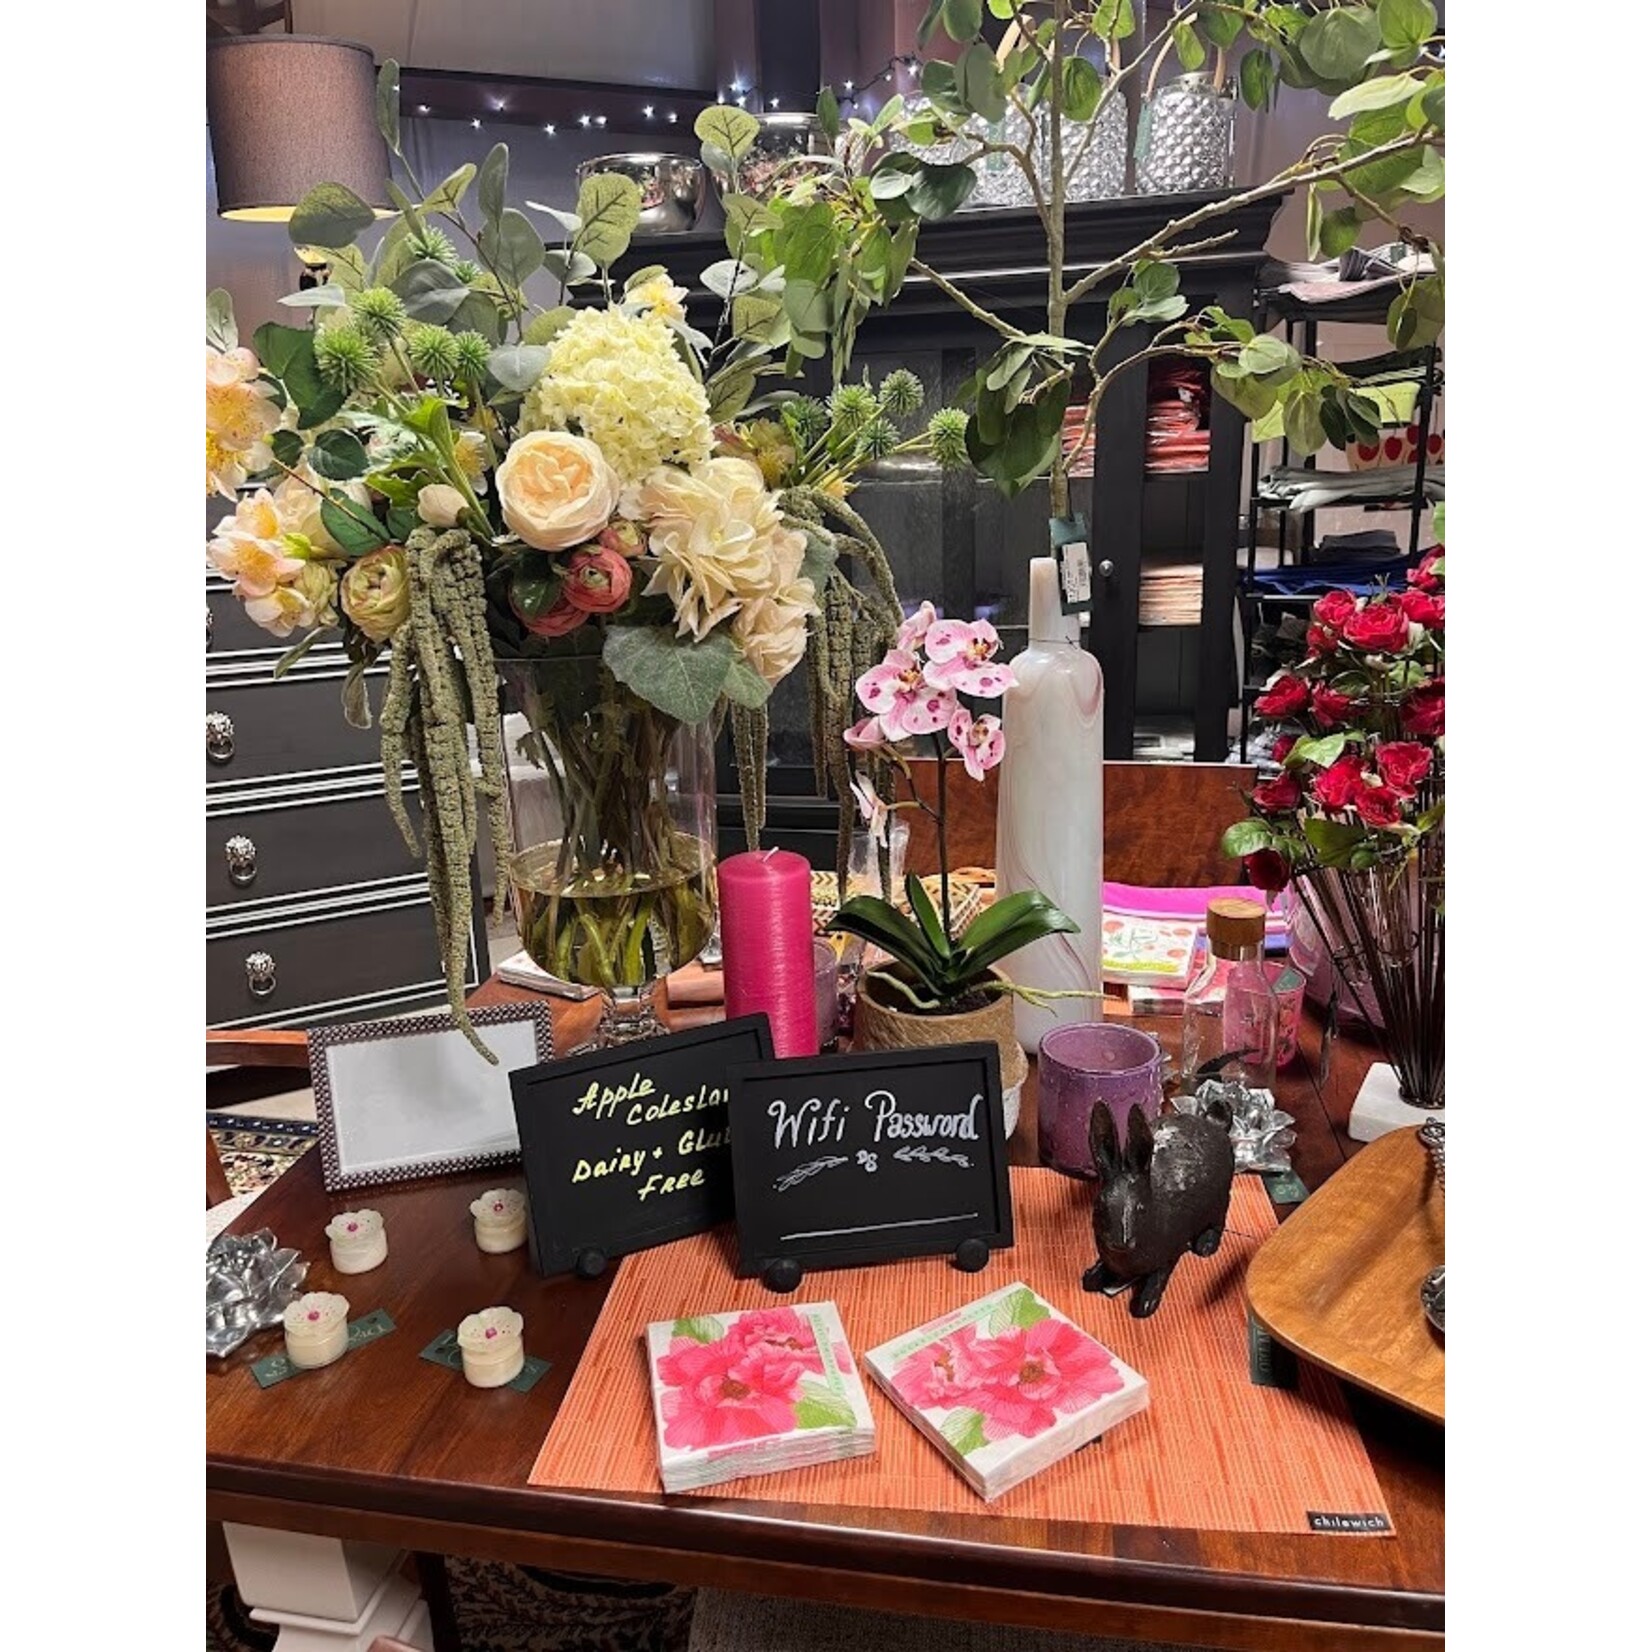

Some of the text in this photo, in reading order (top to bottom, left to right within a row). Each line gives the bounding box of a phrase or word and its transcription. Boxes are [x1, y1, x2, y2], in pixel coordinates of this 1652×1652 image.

[572, 1072, 656, 1120] Apple
[767, 1090, 984, 1149] Wifi Password
[572, 1147, 646, 1183] Dairy
